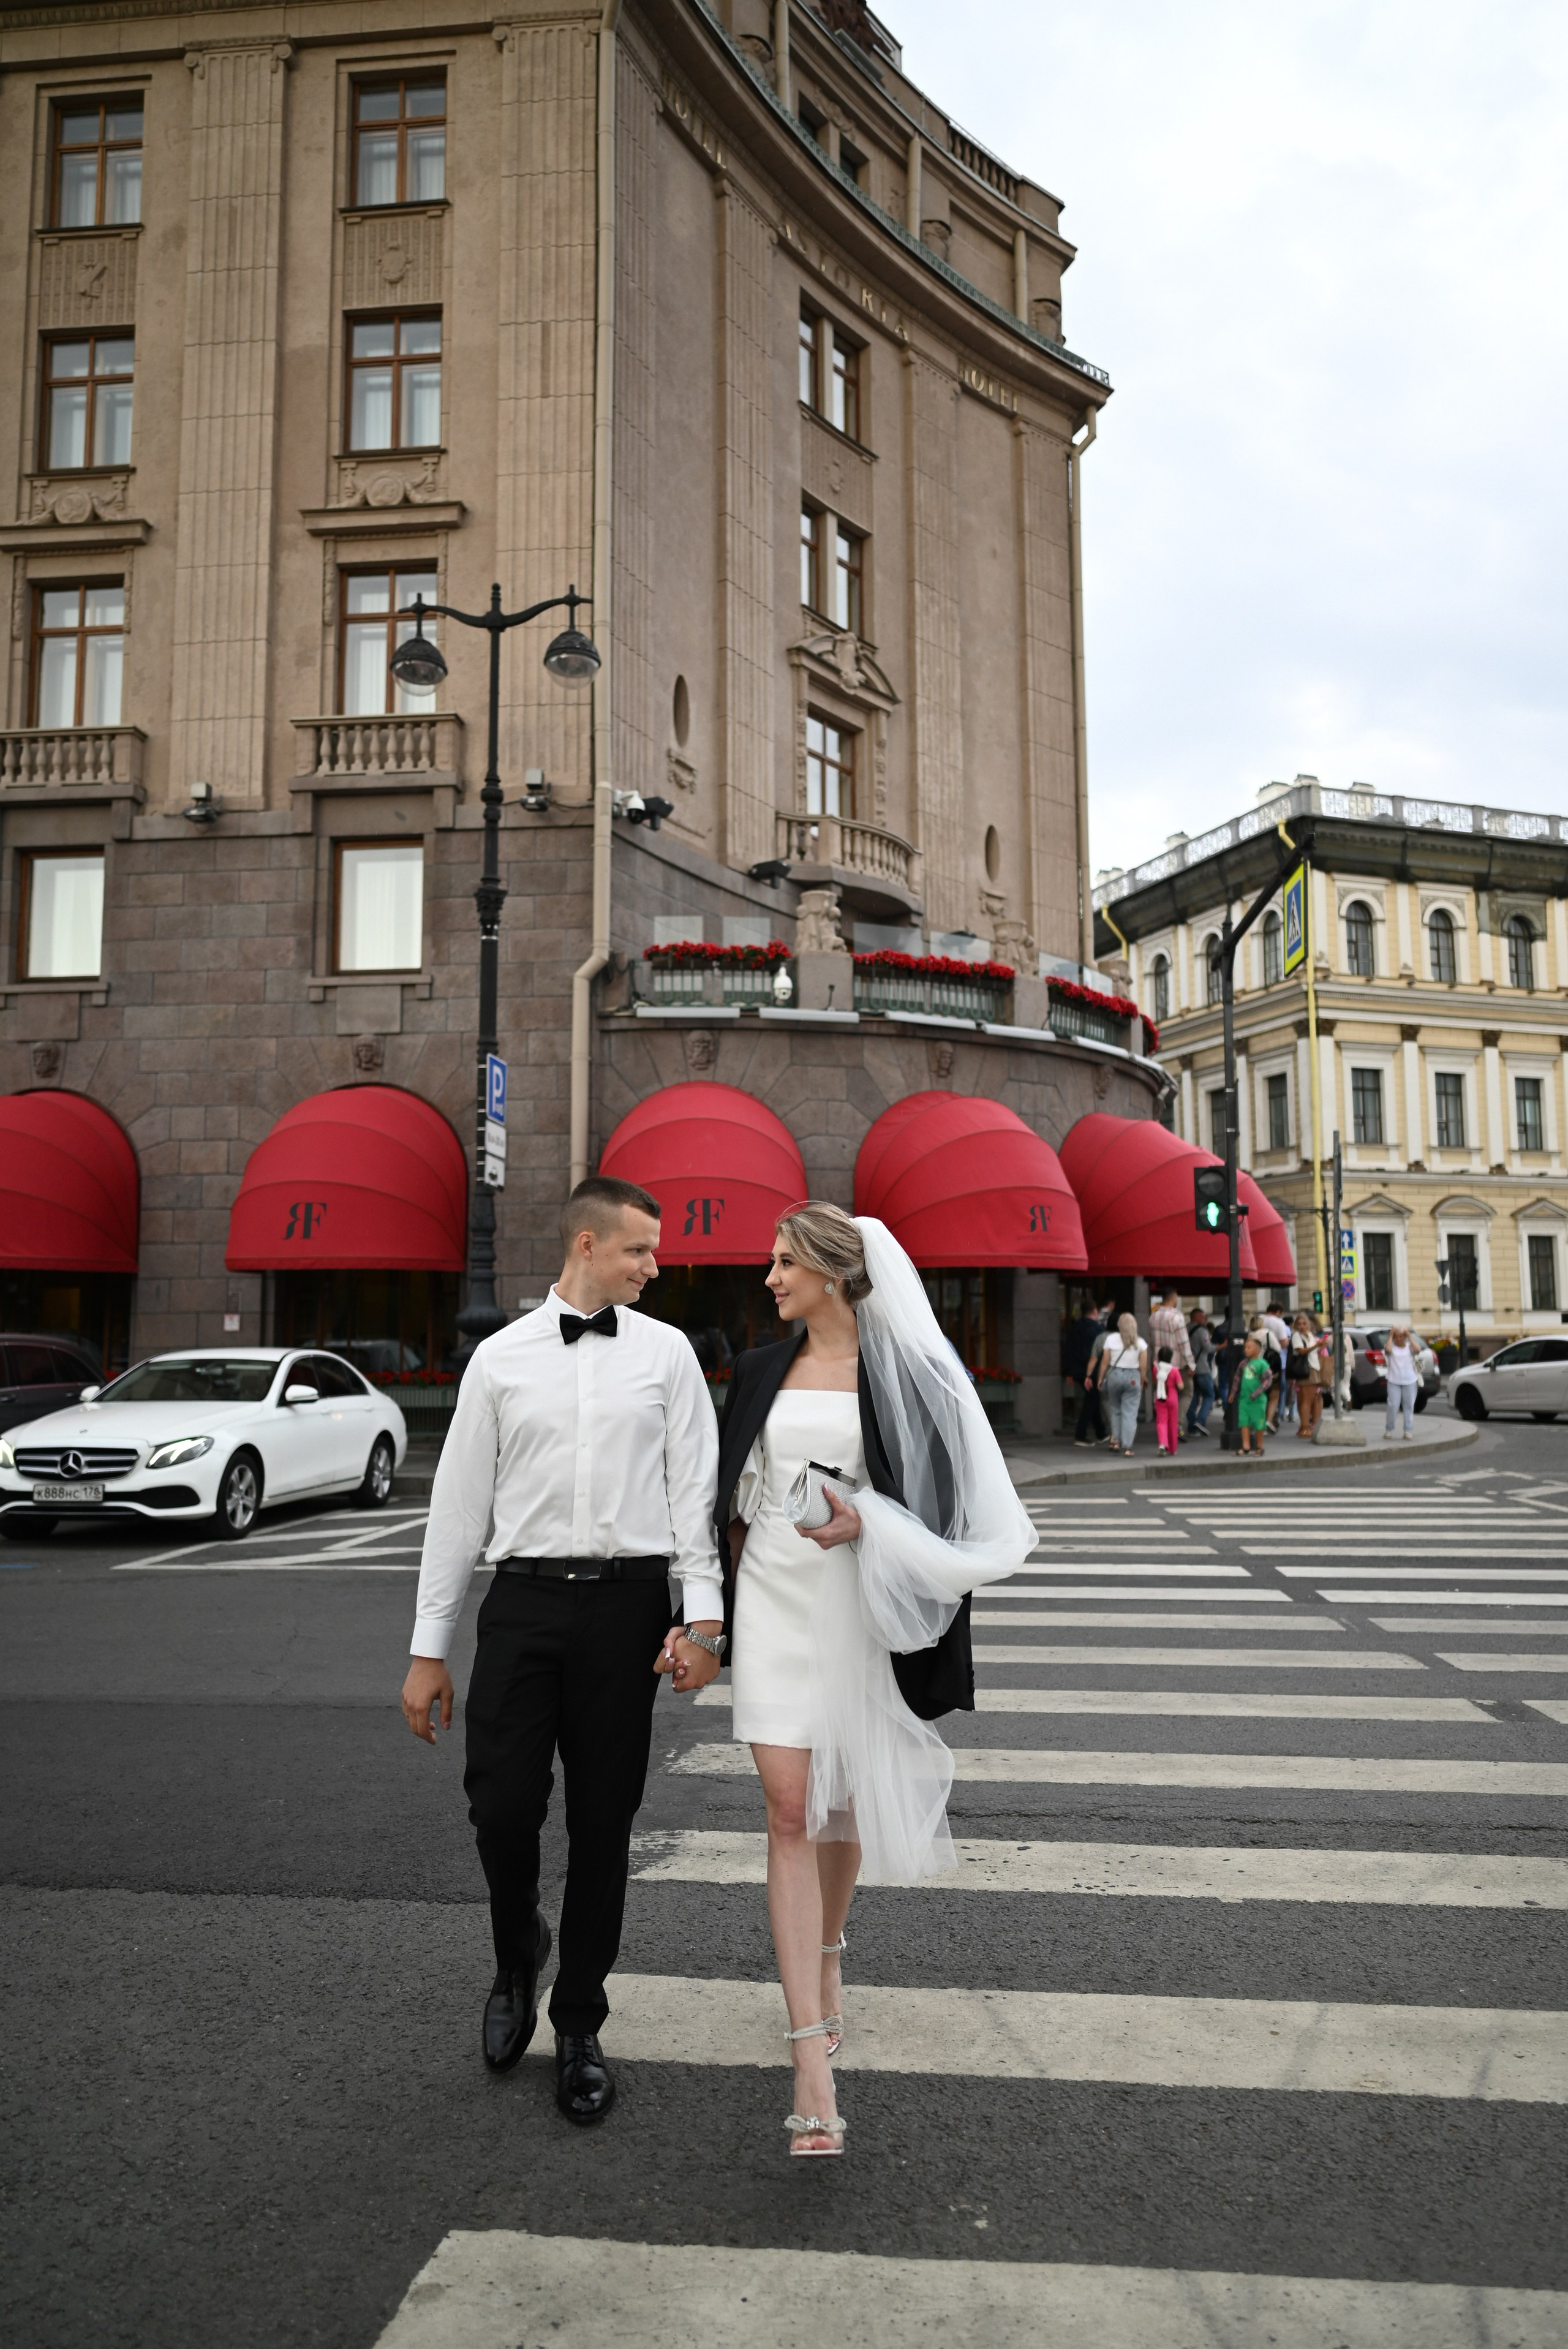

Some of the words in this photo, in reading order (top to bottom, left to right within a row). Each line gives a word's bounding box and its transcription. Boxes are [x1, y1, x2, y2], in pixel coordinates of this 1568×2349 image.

[778, 213, 909, 341] ASTORIA
[957, 357, 1017, 412] HOTEL
[492, 1064, 504, 1114] P
